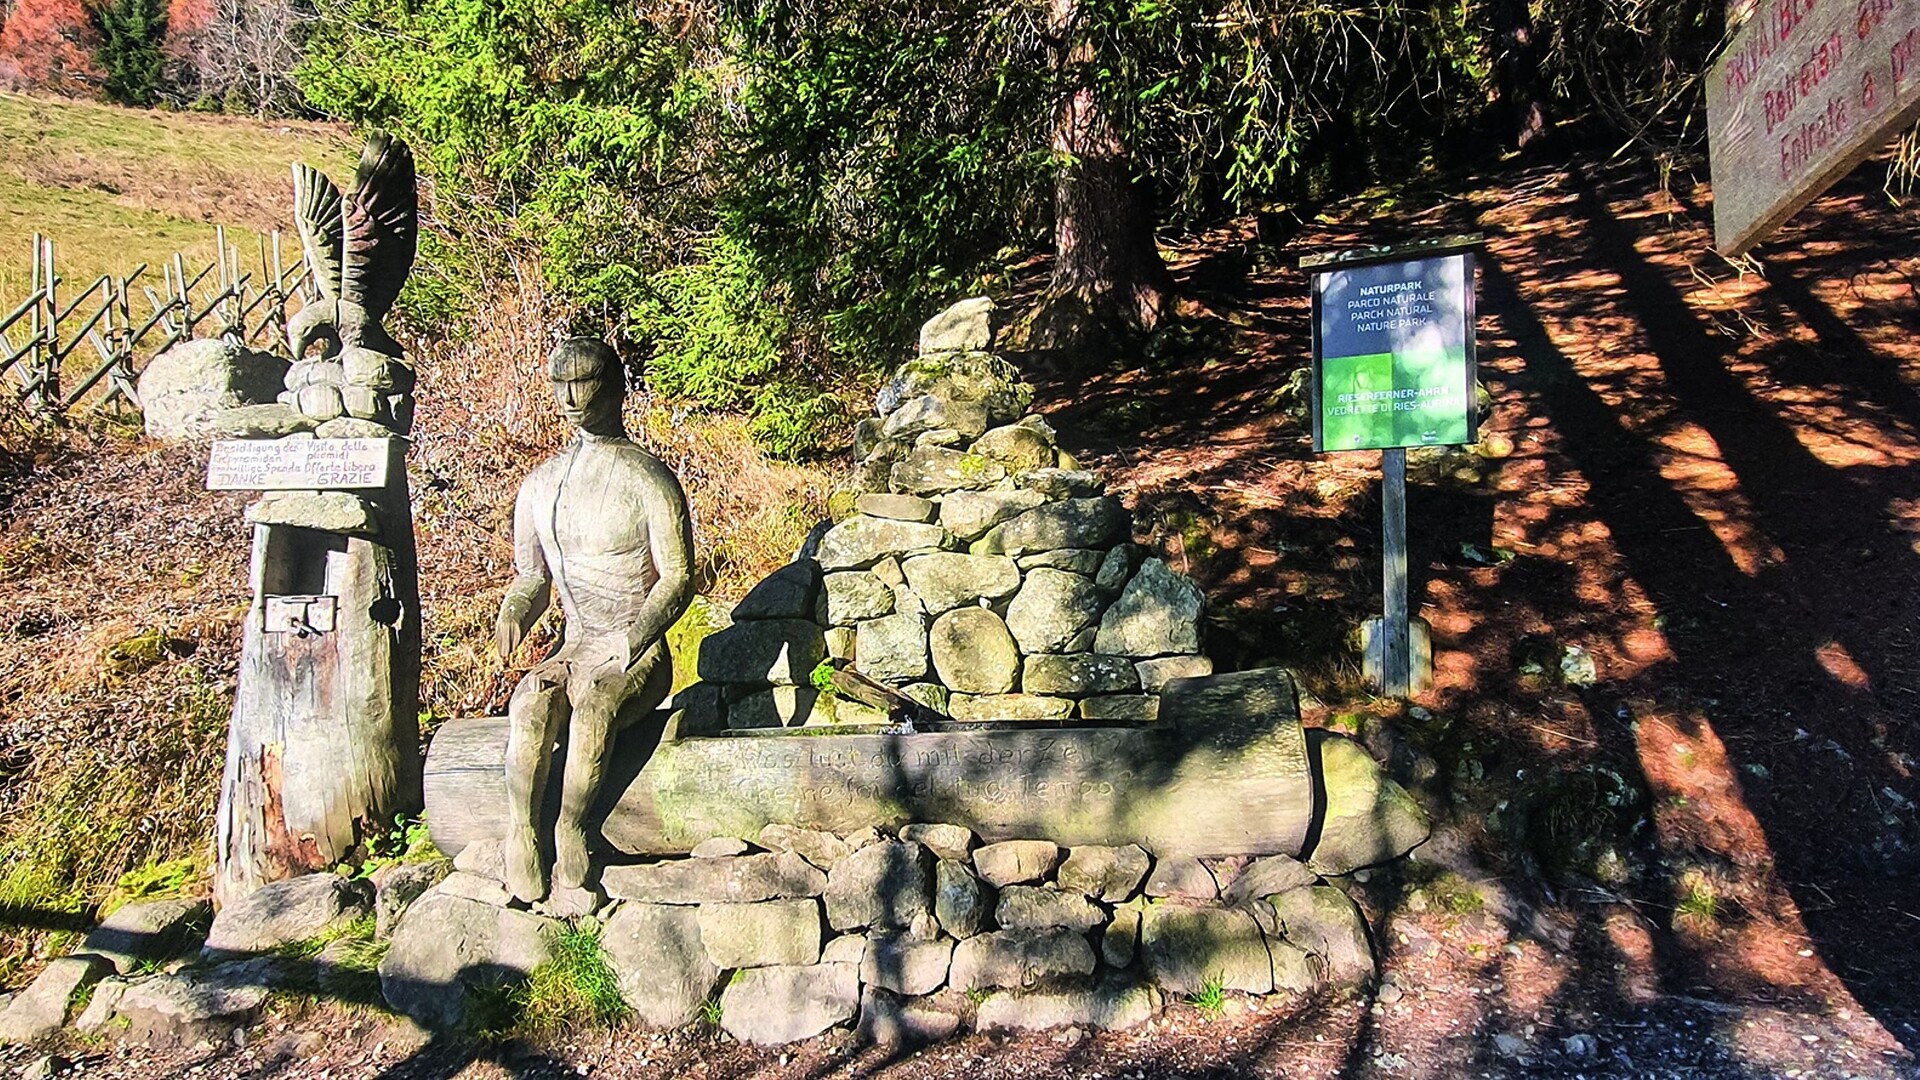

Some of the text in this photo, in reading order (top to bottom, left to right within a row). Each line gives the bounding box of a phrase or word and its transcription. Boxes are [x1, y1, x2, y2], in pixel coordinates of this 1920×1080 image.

[1360, 281, 1422, 296] NATURPARK
[1347, 291, 1436, 310] PARCO NATURALE
[1351, 304, 1433, 321] PARCH NATURAL
[1357, 317, 1427, 333] NATURE PARK
[1381, 402, 1391, 412] DI
[217, 472, 266, 486] DANKE
[317, 471, 372, 485] GRAZIE
